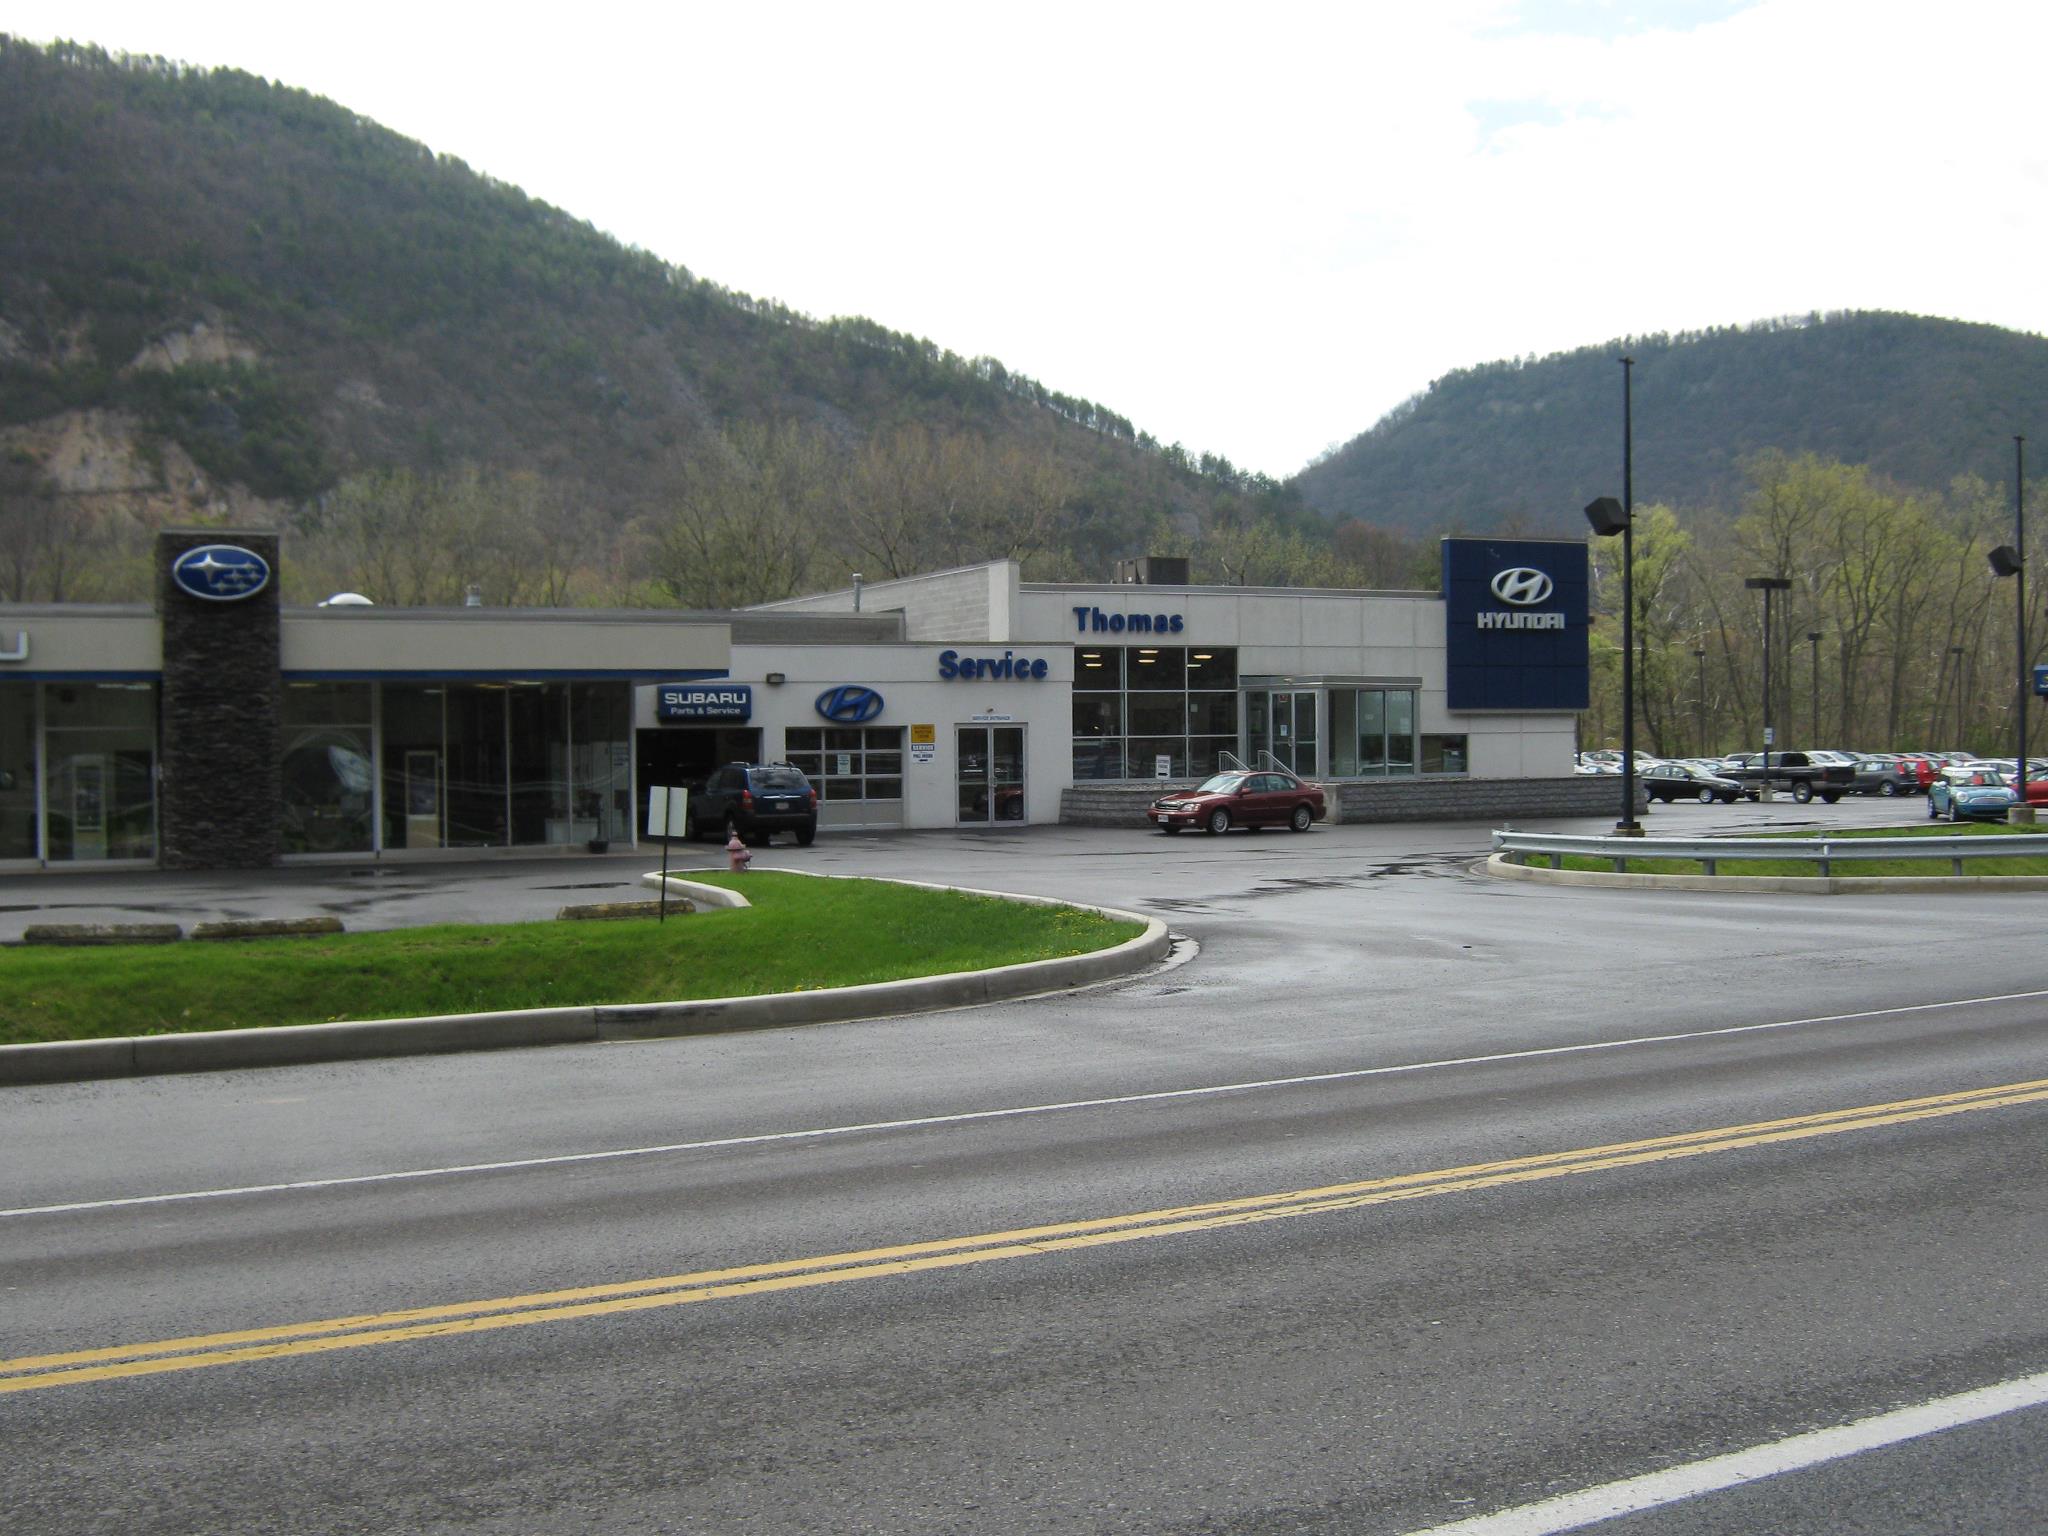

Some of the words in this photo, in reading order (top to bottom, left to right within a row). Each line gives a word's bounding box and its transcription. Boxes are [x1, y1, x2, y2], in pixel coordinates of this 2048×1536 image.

[1072, 607, 1184, 632] Thomas
[1477, 612, 1565, 629] HYUNDAI
[938, 649, 1048, 678] Service
[665, 693, 746, 704] SUBARU
[672, 707, 695, 715] Parts
[697, 707, 705, 715] &
[707, 707, 741, 715] Service
